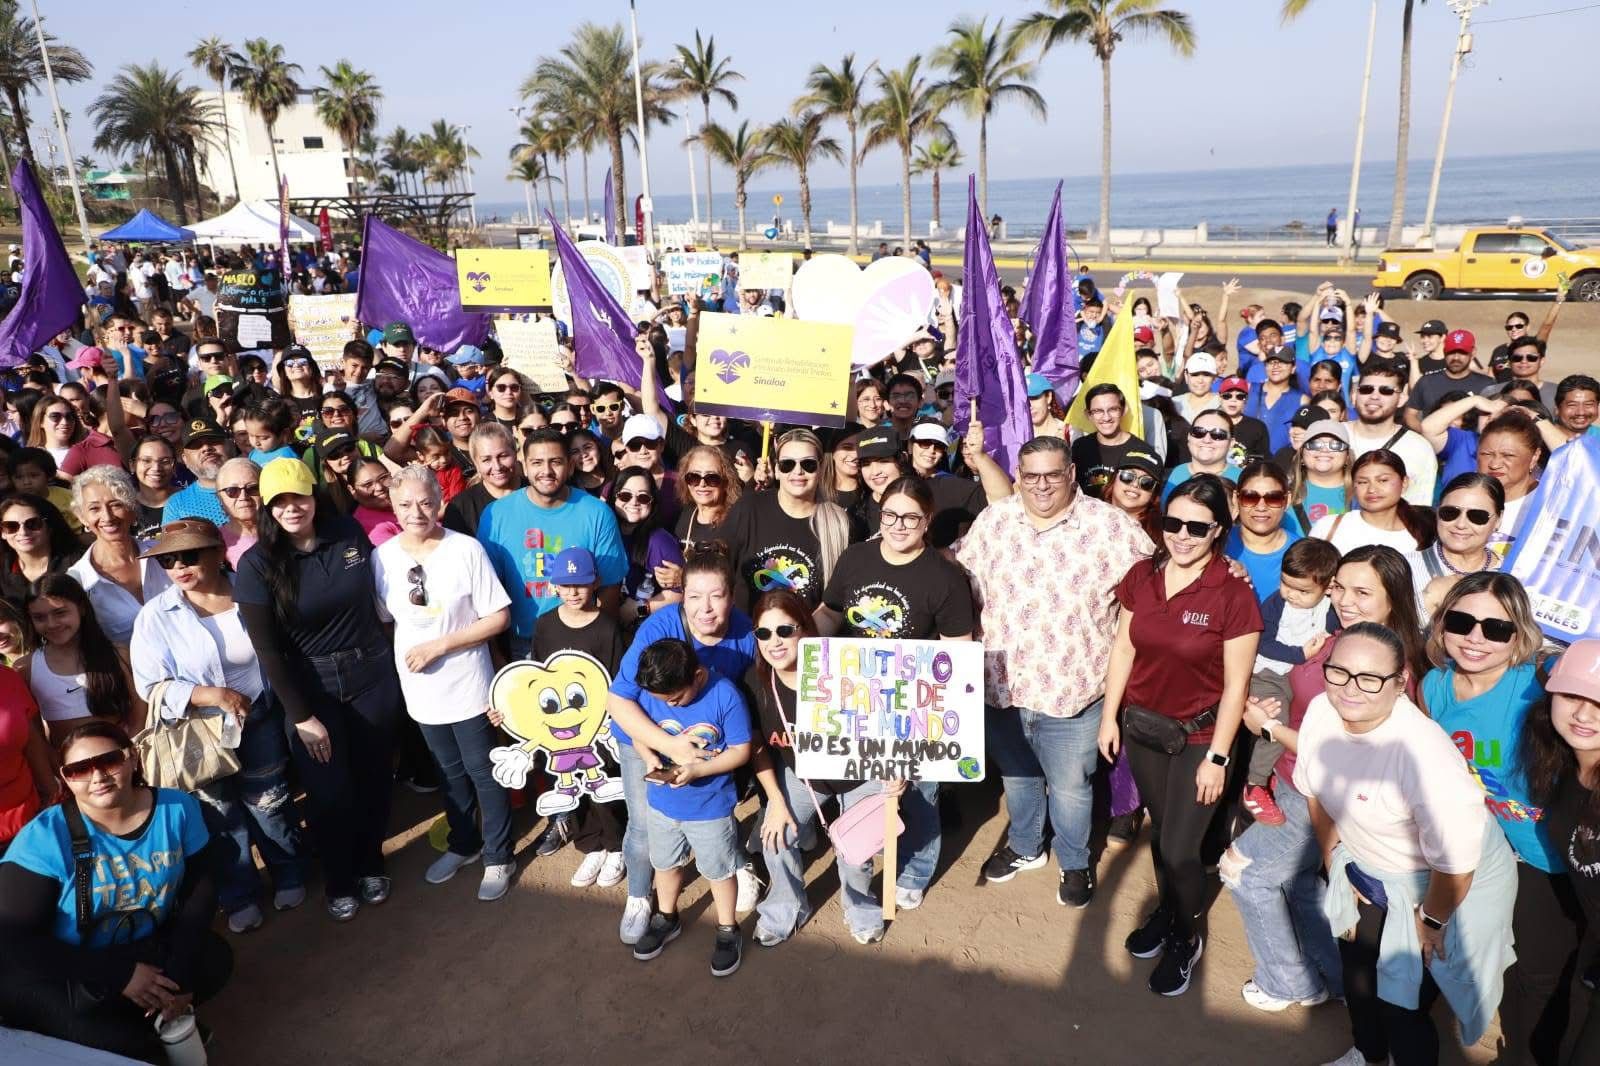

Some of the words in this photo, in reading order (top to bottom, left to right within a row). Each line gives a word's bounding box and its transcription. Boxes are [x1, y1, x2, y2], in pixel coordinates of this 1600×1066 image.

[753, 376, 786, 387] Sinaloa
[566, 560, 577, 574] LA
[1191, 612, 1210, 625] DIF
[839, 643, 953, 683] AUTISMO
[800, 673, 834, 703] ES
[841, 676, 908, 713] PARTE
[916, 678, 947, 712] DE
[811, 702, 869, 741] ESTE
[878, 708, 960, 742] MUNDO
[798, 731, 823, 753] NO
[826, 735, 851, 755] ES
[857, 738, 886, 760] UN
[891, 738, 962, 762] MUNDO
[843, 758, 923, 781] APARTE
